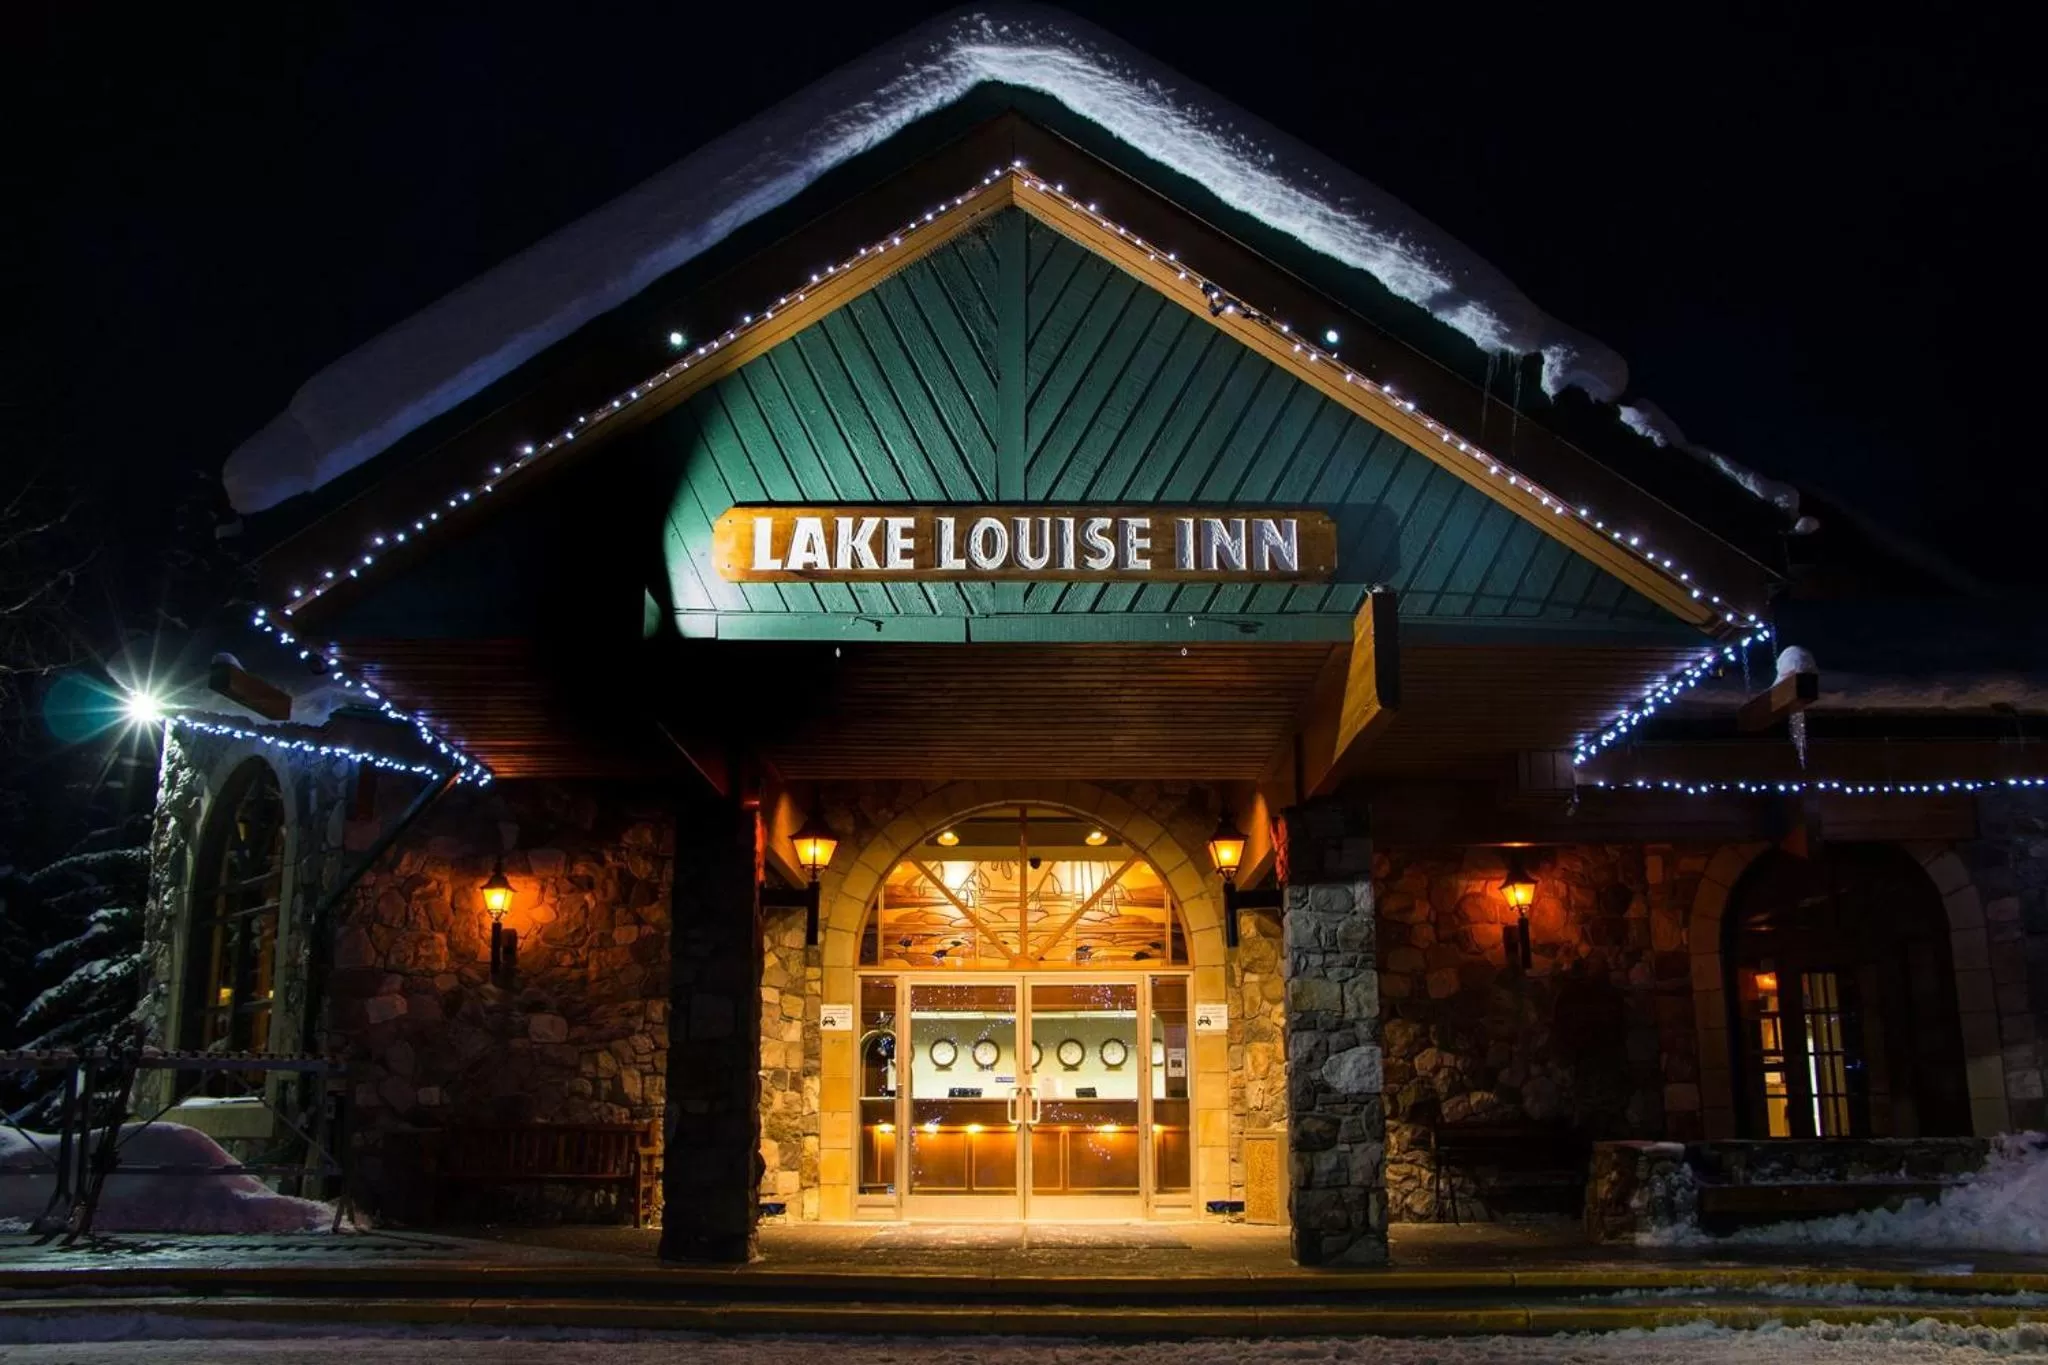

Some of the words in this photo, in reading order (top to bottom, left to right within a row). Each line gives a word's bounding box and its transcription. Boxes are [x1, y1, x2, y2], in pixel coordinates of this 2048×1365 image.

[752, 516, 915, 570] LAKE
[934, 517, 1151, 570] LOUISE
[1175, 518, 1299, 571] INN
